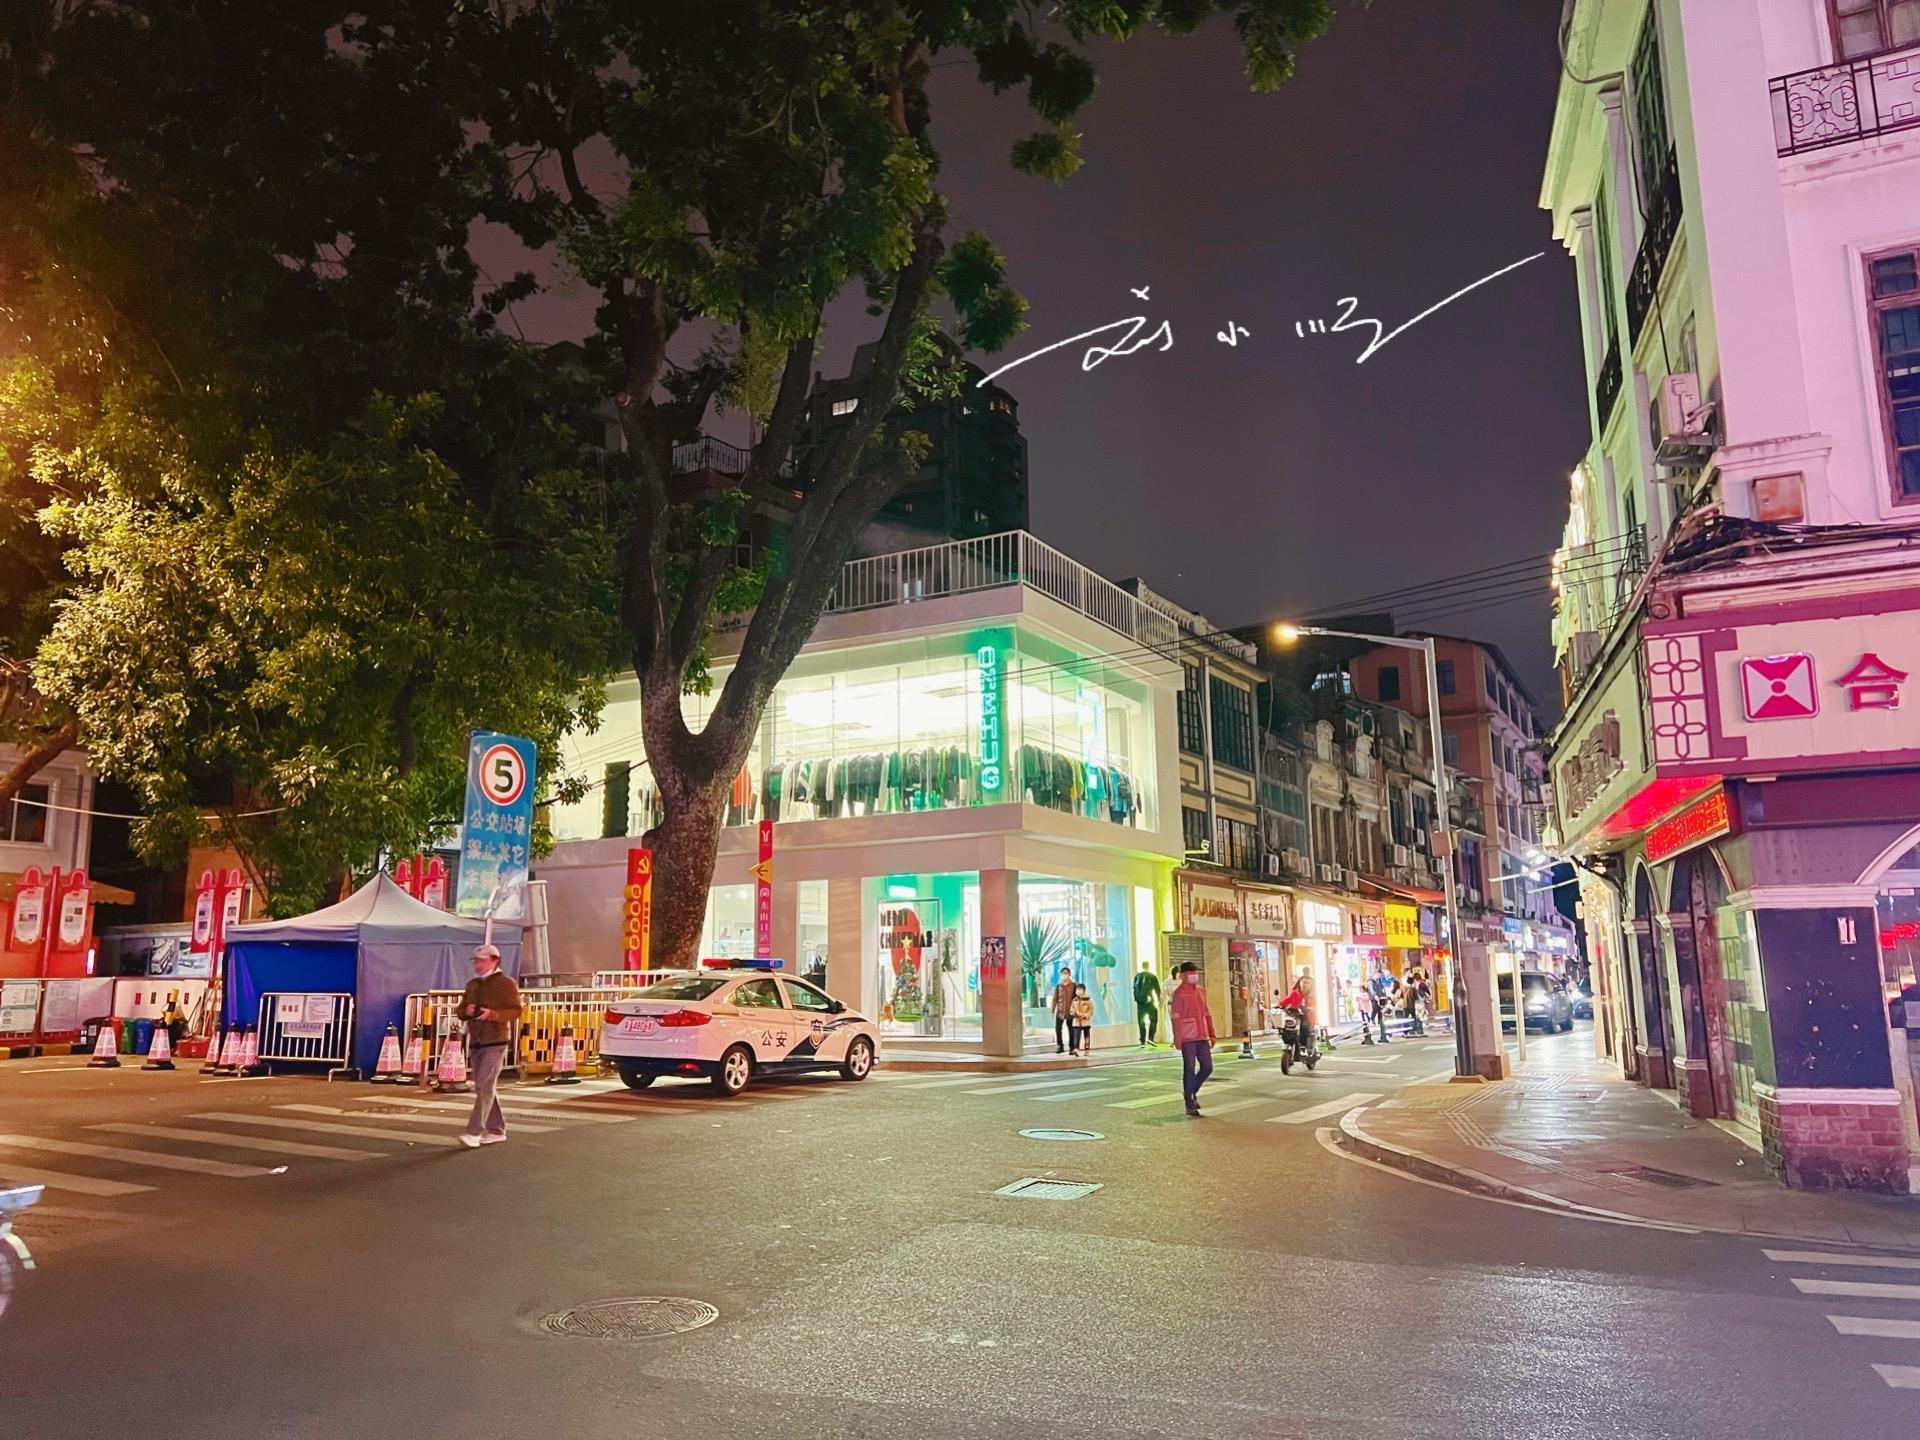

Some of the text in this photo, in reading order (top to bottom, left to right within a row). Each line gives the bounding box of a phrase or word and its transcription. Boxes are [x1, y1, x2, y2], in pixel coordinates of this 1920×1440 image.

[1835, 652, 1910, 711] 合
[494, 758, 514, 793] 5
[469, 810, 527, 836] 公交站场
[466, 838, 525, 865] 禁止其它
[761, 1030, 788, 1048] 公安
